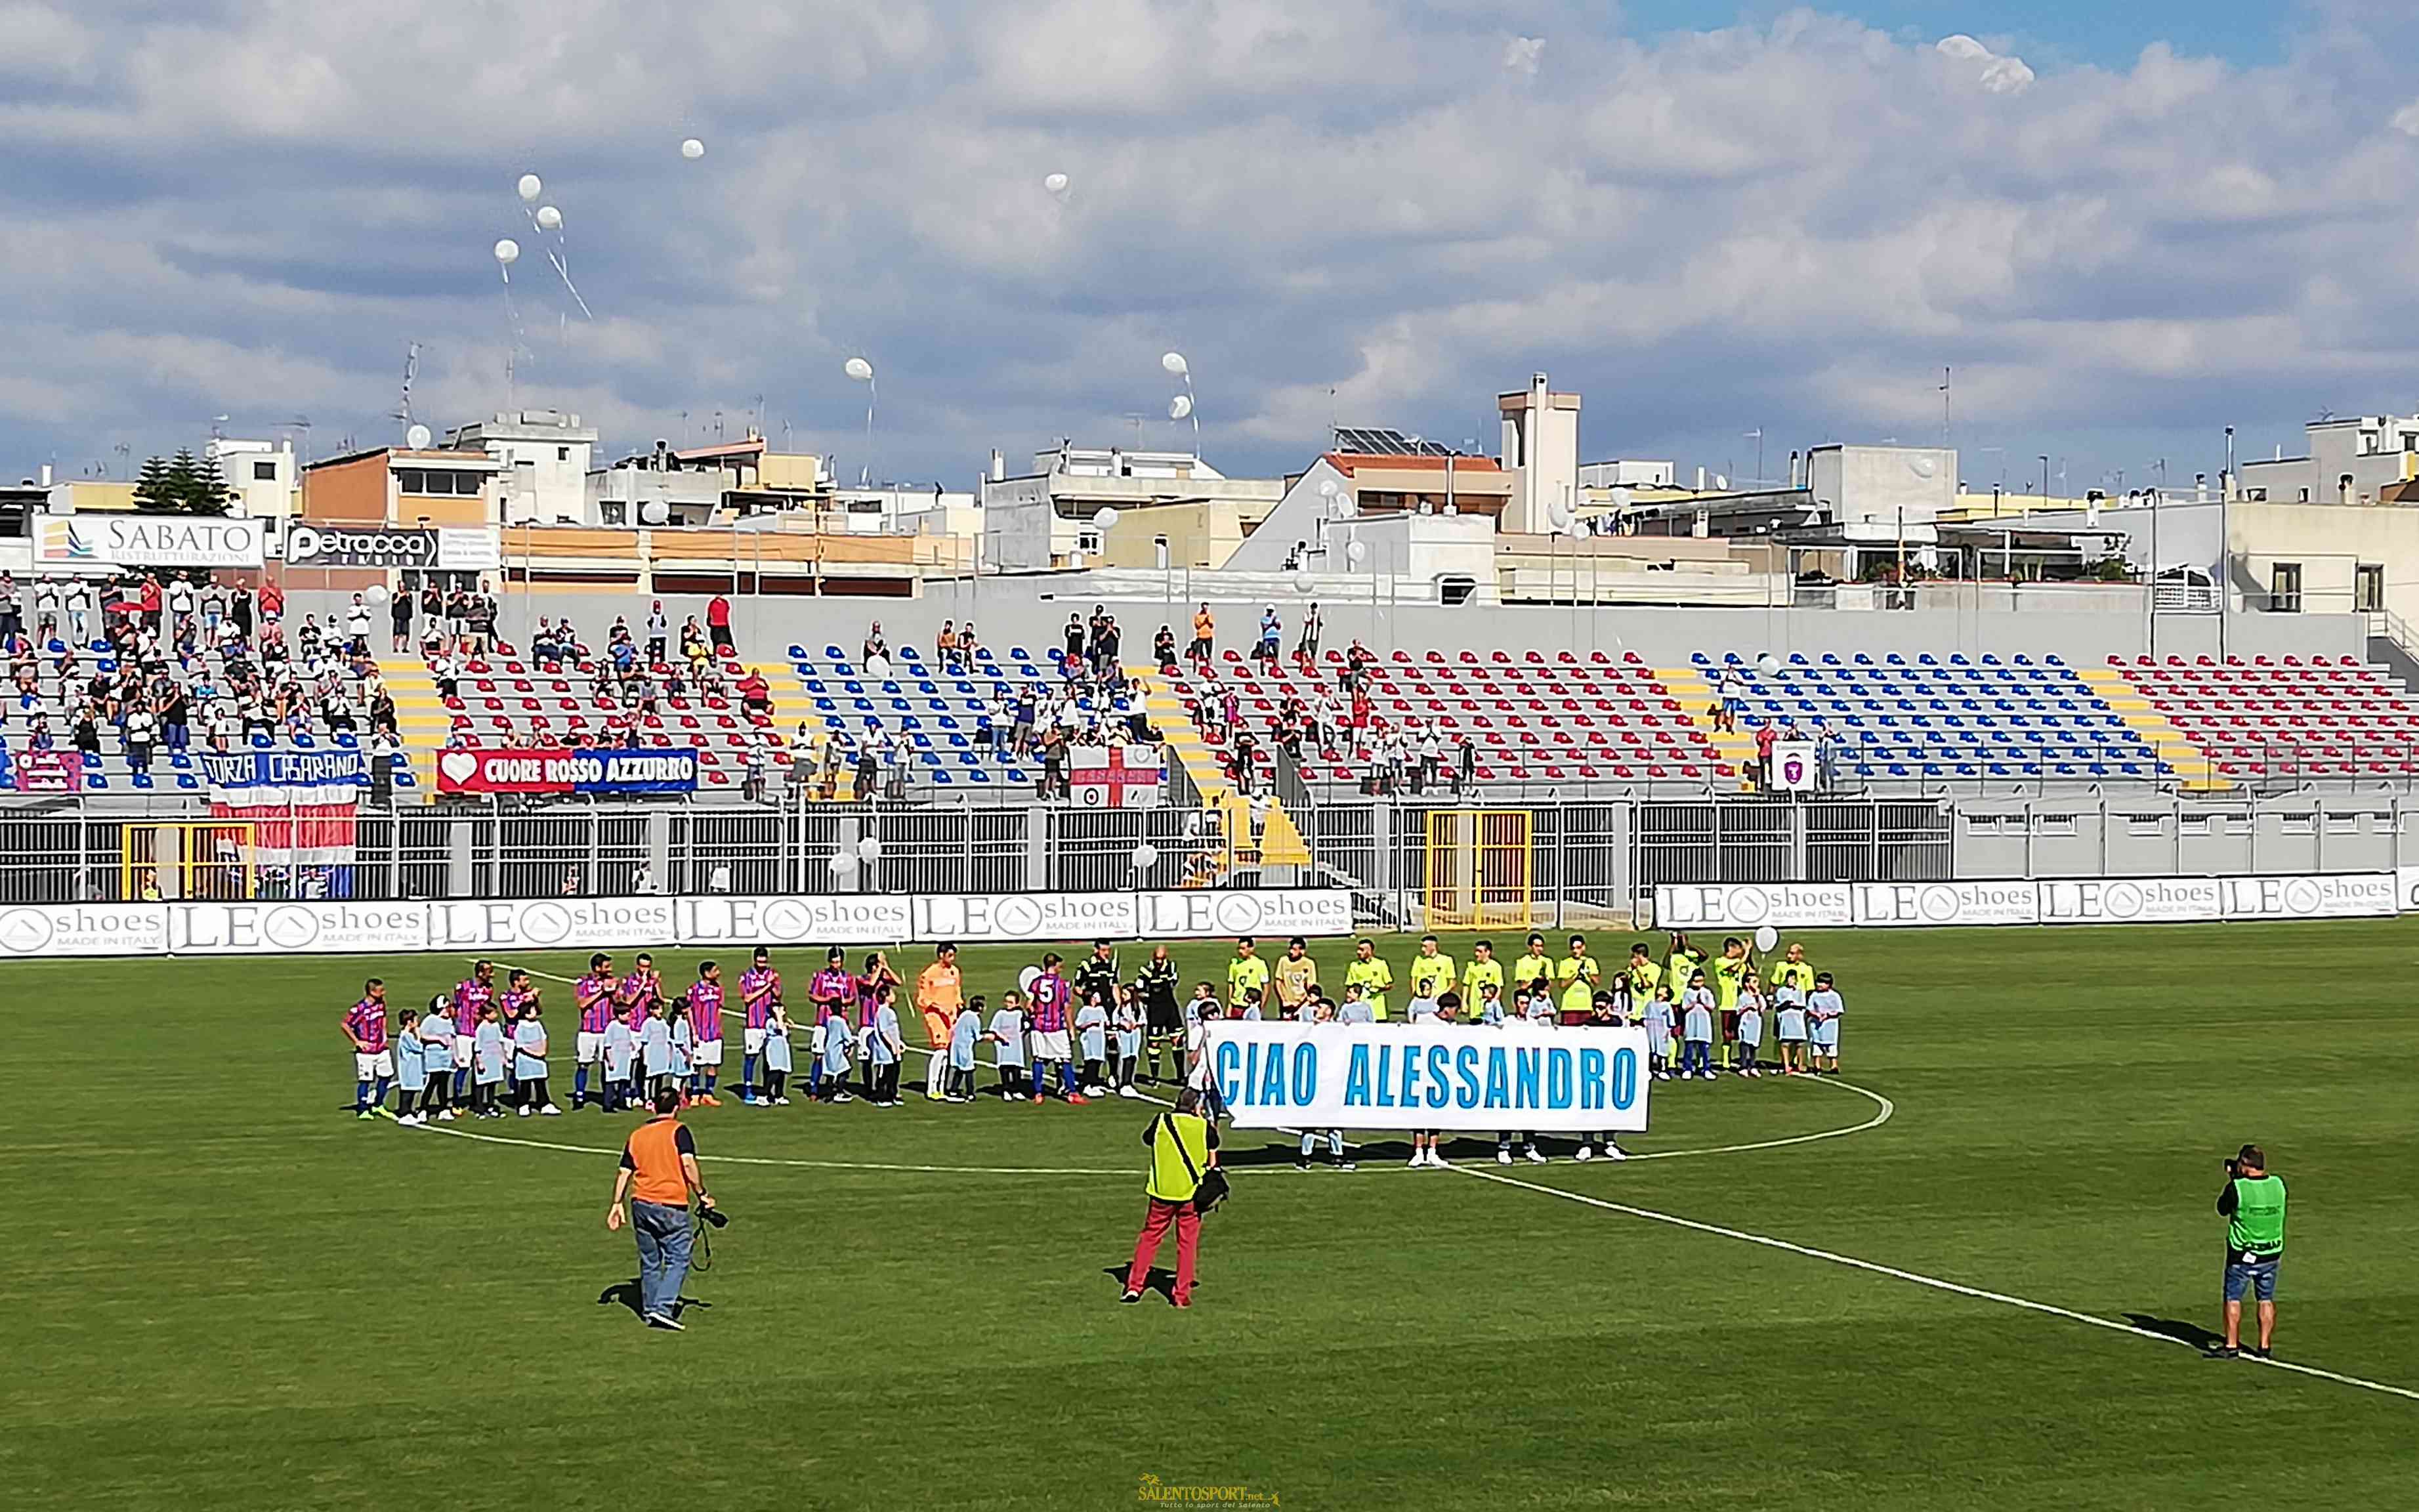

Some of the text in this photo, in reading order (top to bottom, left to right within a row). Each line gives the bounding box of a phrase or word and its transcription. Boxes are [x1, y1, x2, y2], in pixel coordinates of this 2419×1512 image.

[109, 520, 250, 551] SABATO
[111, 550, 249, 562] RISTRUTTURAZIONI
[484, 757, 694, 783] CUORE ROSSO AZZURRO
[1771, 887, 1845, 908] shoes
[1961, 885, 2032, 906] shoes
[2145, 883, 2214, 902] shoes
[2323, 879, 2391, 898] shoes
[574, 902, 667, 925] shoes
[815, 899, 904, 922] shoes
[1045, 896, 1129, 918] shoes
[1263, 894, 1345, 915] shoes
[56, 908, 160, 933] shoes
[322, 906, 419, 929] shoes
[57, 937, 98, 946] MADE
[104, 937, 119, 946] IN
[1039, 978, 1054, 1003] 5
[1216, 1040, 1637, 1111] CIAO ALESSANDRO
